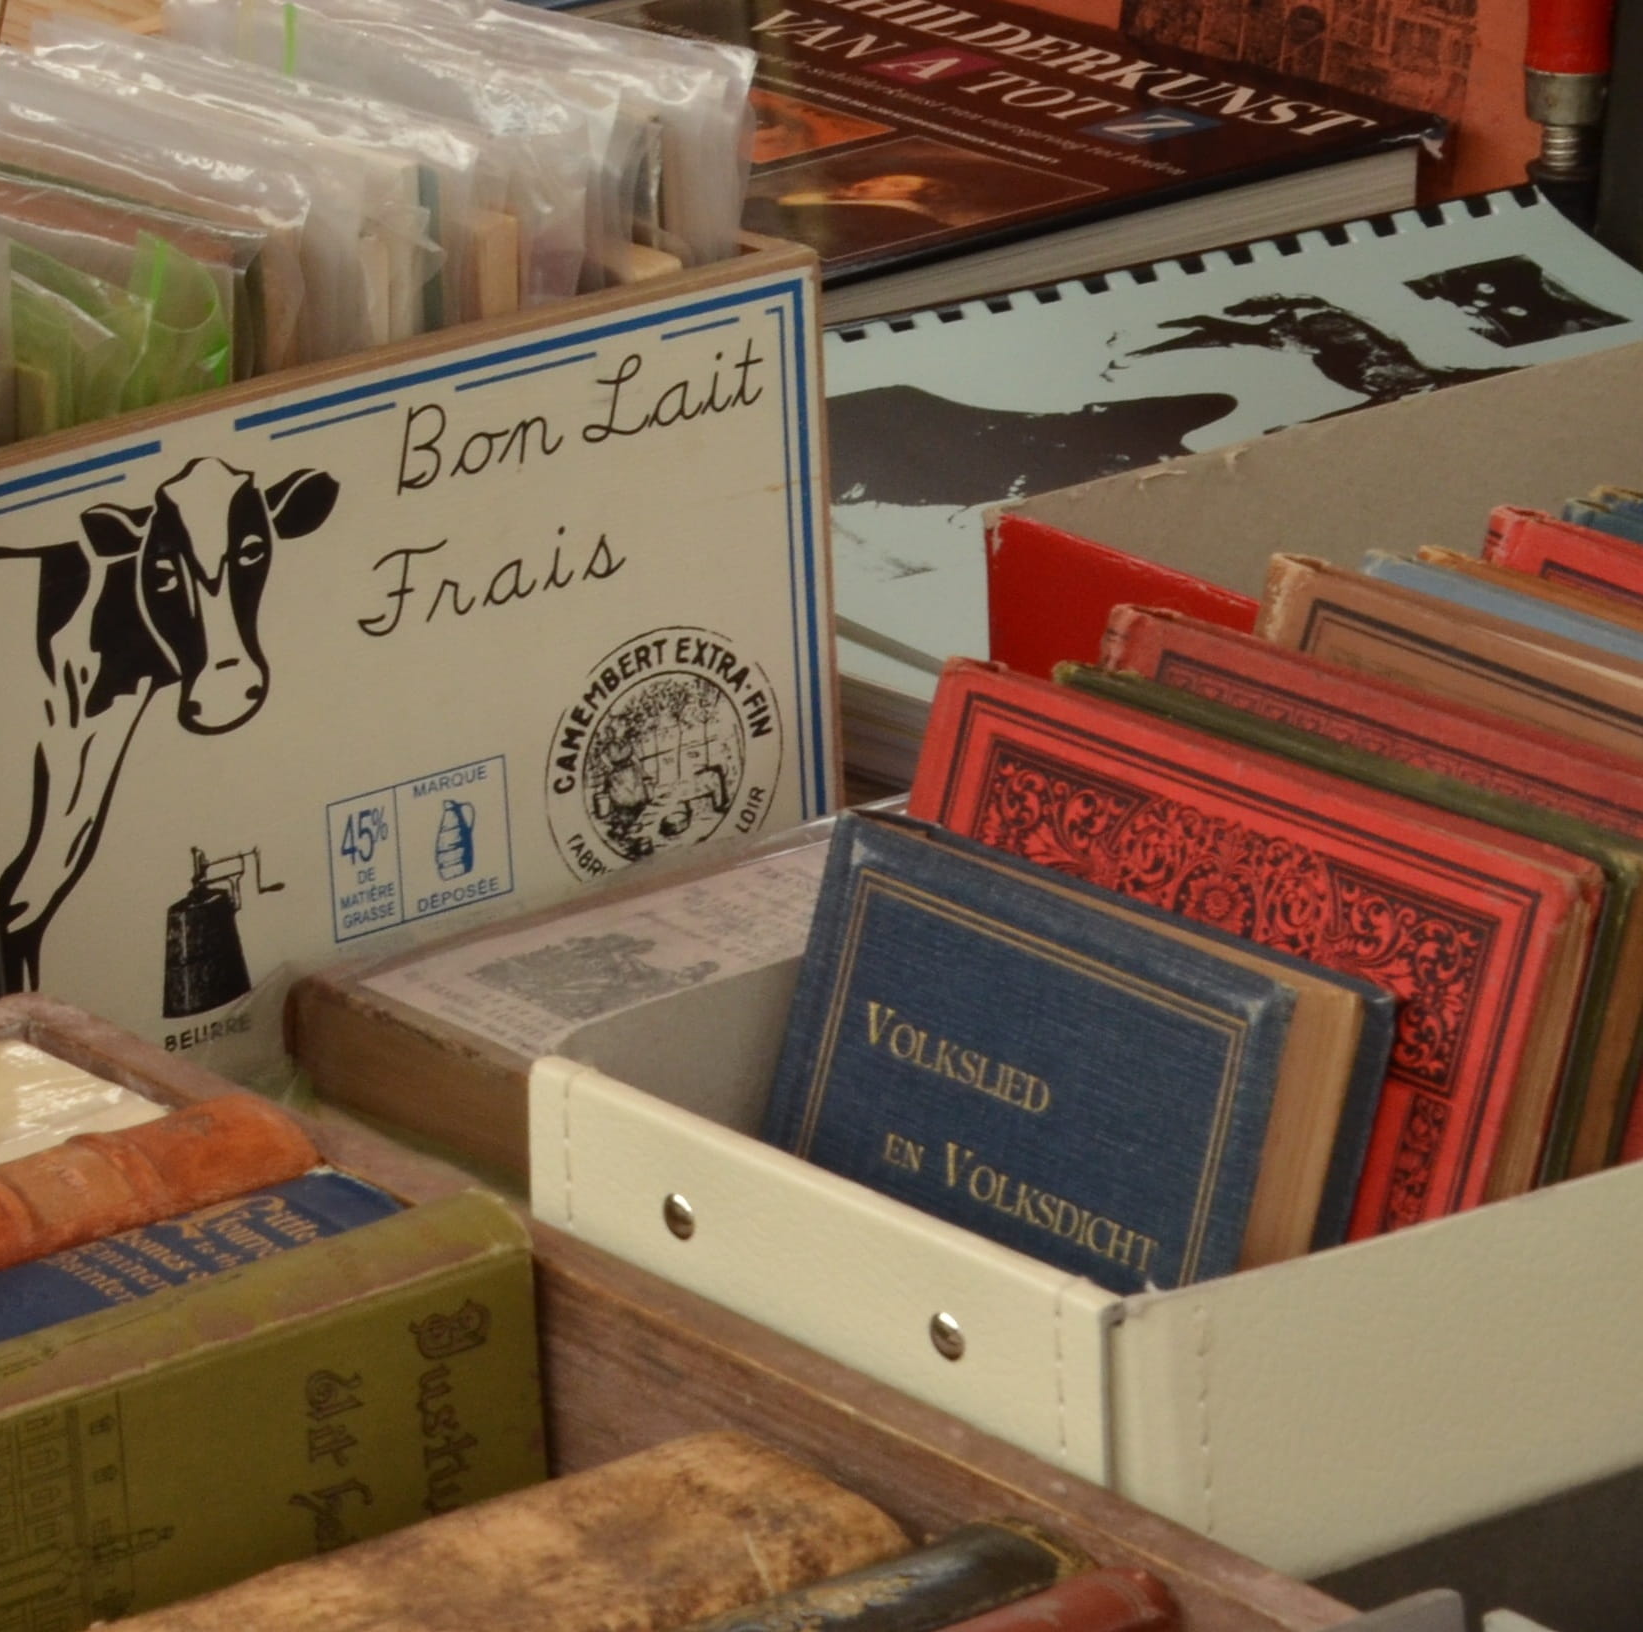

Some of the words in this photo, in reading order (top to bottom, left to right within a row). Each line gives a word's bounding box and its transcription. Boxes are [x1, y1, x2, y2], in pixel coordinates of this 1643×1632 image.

[751, 8, 905, 62] VAN
[882, 47, 961, 80] A
[959, 71, 1131, 120] TOT
[1101, 114, 1194, 139] Z
[397, 404, 564, 495] Bon
[582, 338, 763, 443] Lait
[357, 526, 626, 637] Frais
[553, 639, 668, 795] CAMEMBERT
[413, 765, 488, 799] MARQUE
[340, 807, 388, 866] 45%
[340, 880, 395, 910] MATIÈRE
[356, 868, 376, 884] DE
[418, 877, 500, 913] DÉPOSÉE
[343, 902, 395, 929] GRASSE
[164, 1013, 253, 1052] BEURRE
[866, 1000, 1050, 1114] VOLKSLIED
[884, 1132, 925, 1172] EN
[945, 1142, 1158, 1272] VOLKSDICHT
